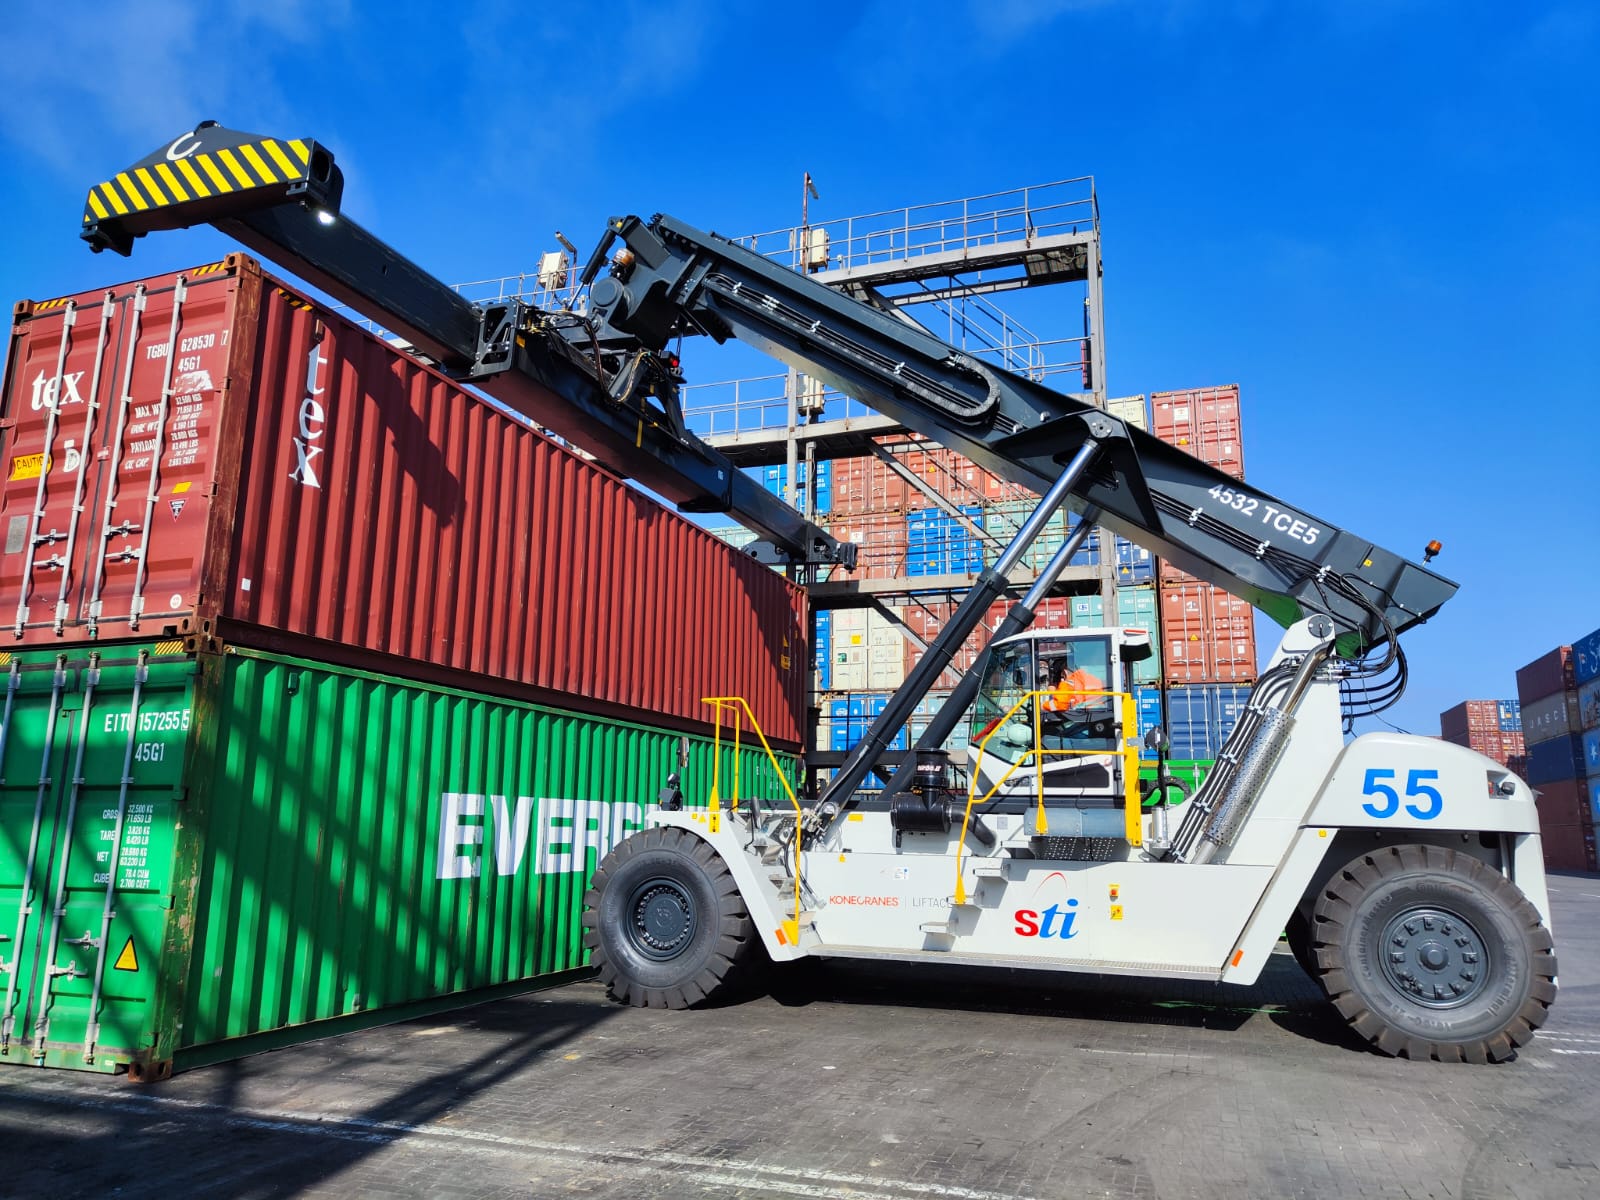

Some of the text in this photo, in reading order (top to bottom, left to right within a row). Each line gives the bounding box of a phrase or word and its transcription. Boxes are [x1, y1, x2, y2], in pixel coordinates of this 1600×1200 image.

[146, 343, 170, 359] TGBU
[181, 334, 215, 352] 628530
[177, 356, 201, 372] 45G1
[31, 369, 85, 411] tex
[152, 402, 162, 416] W
[1208, 484, 1320, 545] 4532 TCE5
[139, 711, 180, 731] 157255
[134, 742, 165, 761] 45G1
[1362, 768, 1443, 820] 55
[102, 809, 119, 819] GROS
[100, 829, 116, 841] TARE
[436, 792, 661, 879] EVERG
[96, 851, 109, 862] NET
[829, 895, 899, 907] KONECRANES
[1014, 898, 1079, 939] sti
